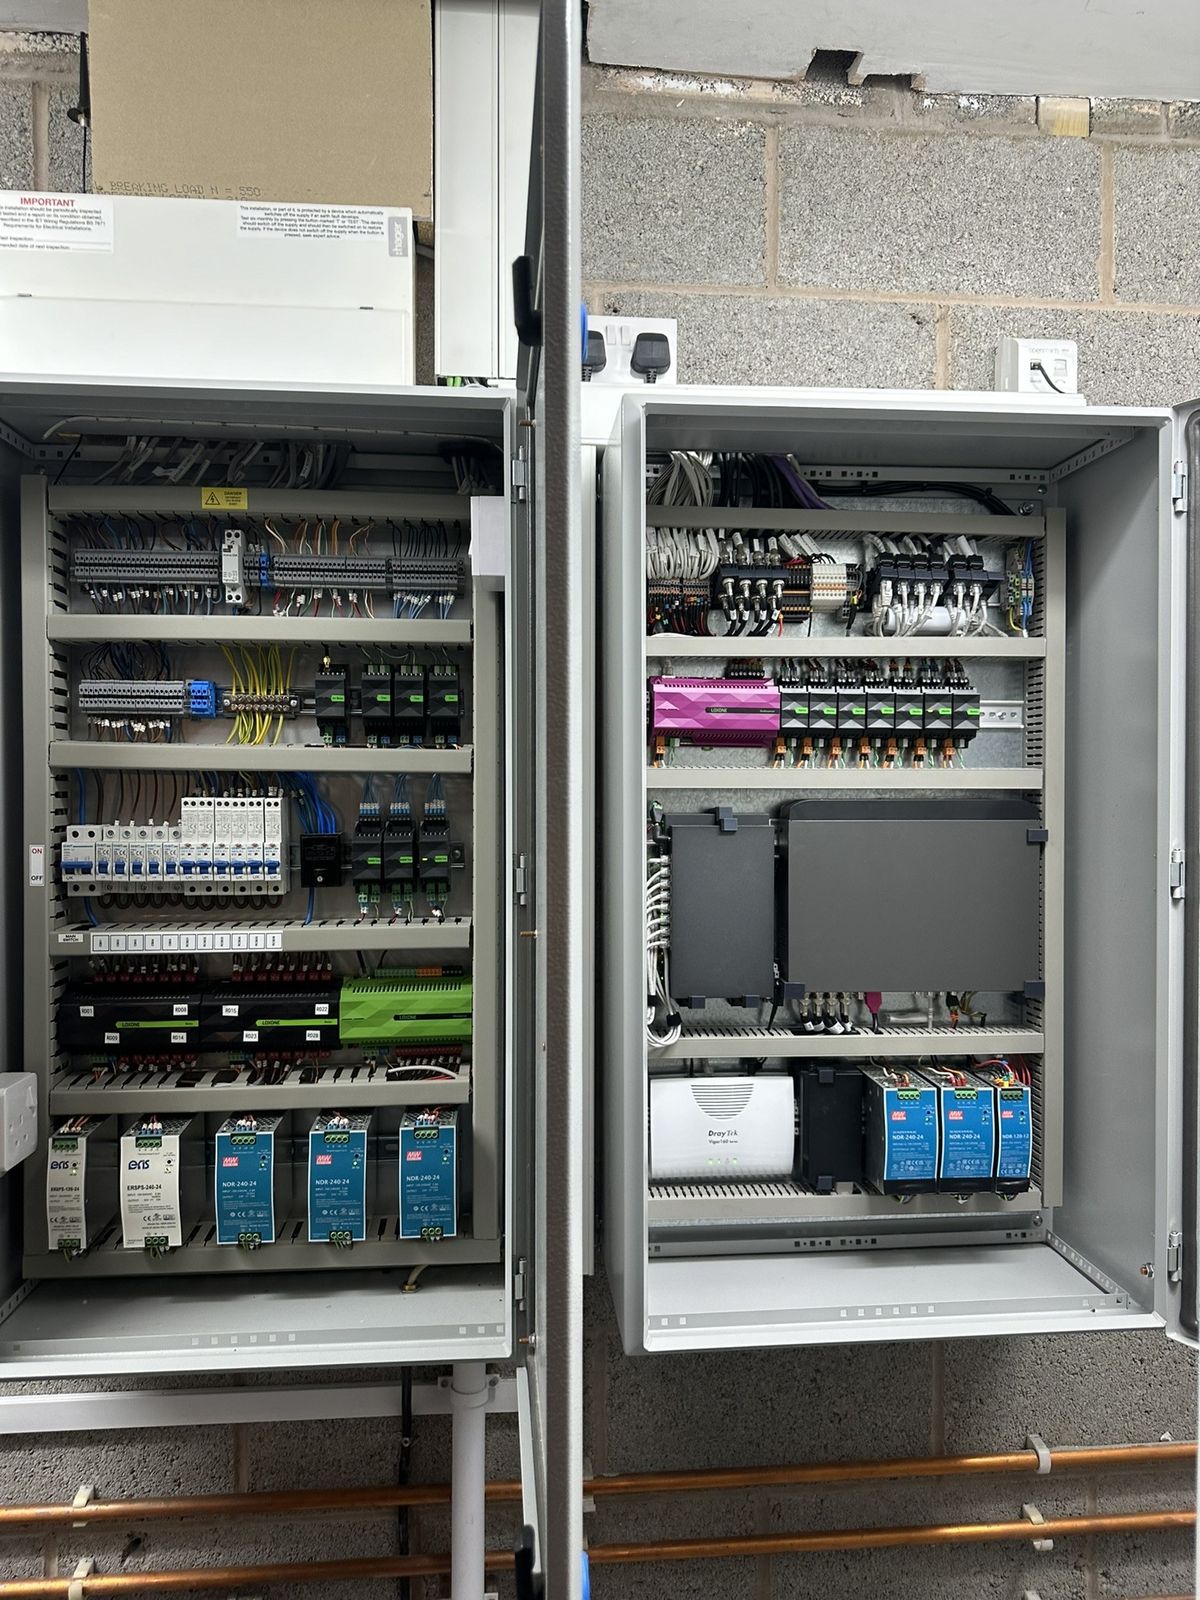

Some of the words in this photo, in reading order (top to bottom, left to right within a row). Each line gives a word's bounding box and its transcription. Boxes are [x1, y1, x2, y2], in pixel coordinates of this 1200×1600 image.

[110, 181, 168, 193] BREAKING
[174, 184, 204, 194] LOAD
[210, 185, 219, 195] N
[239, 186, 261, 197] 550
[20, 197, 76, 207] IMPORTANT
[50, 1160, 69, 1170] eris
[128, 1160, 150, 1170] eris
